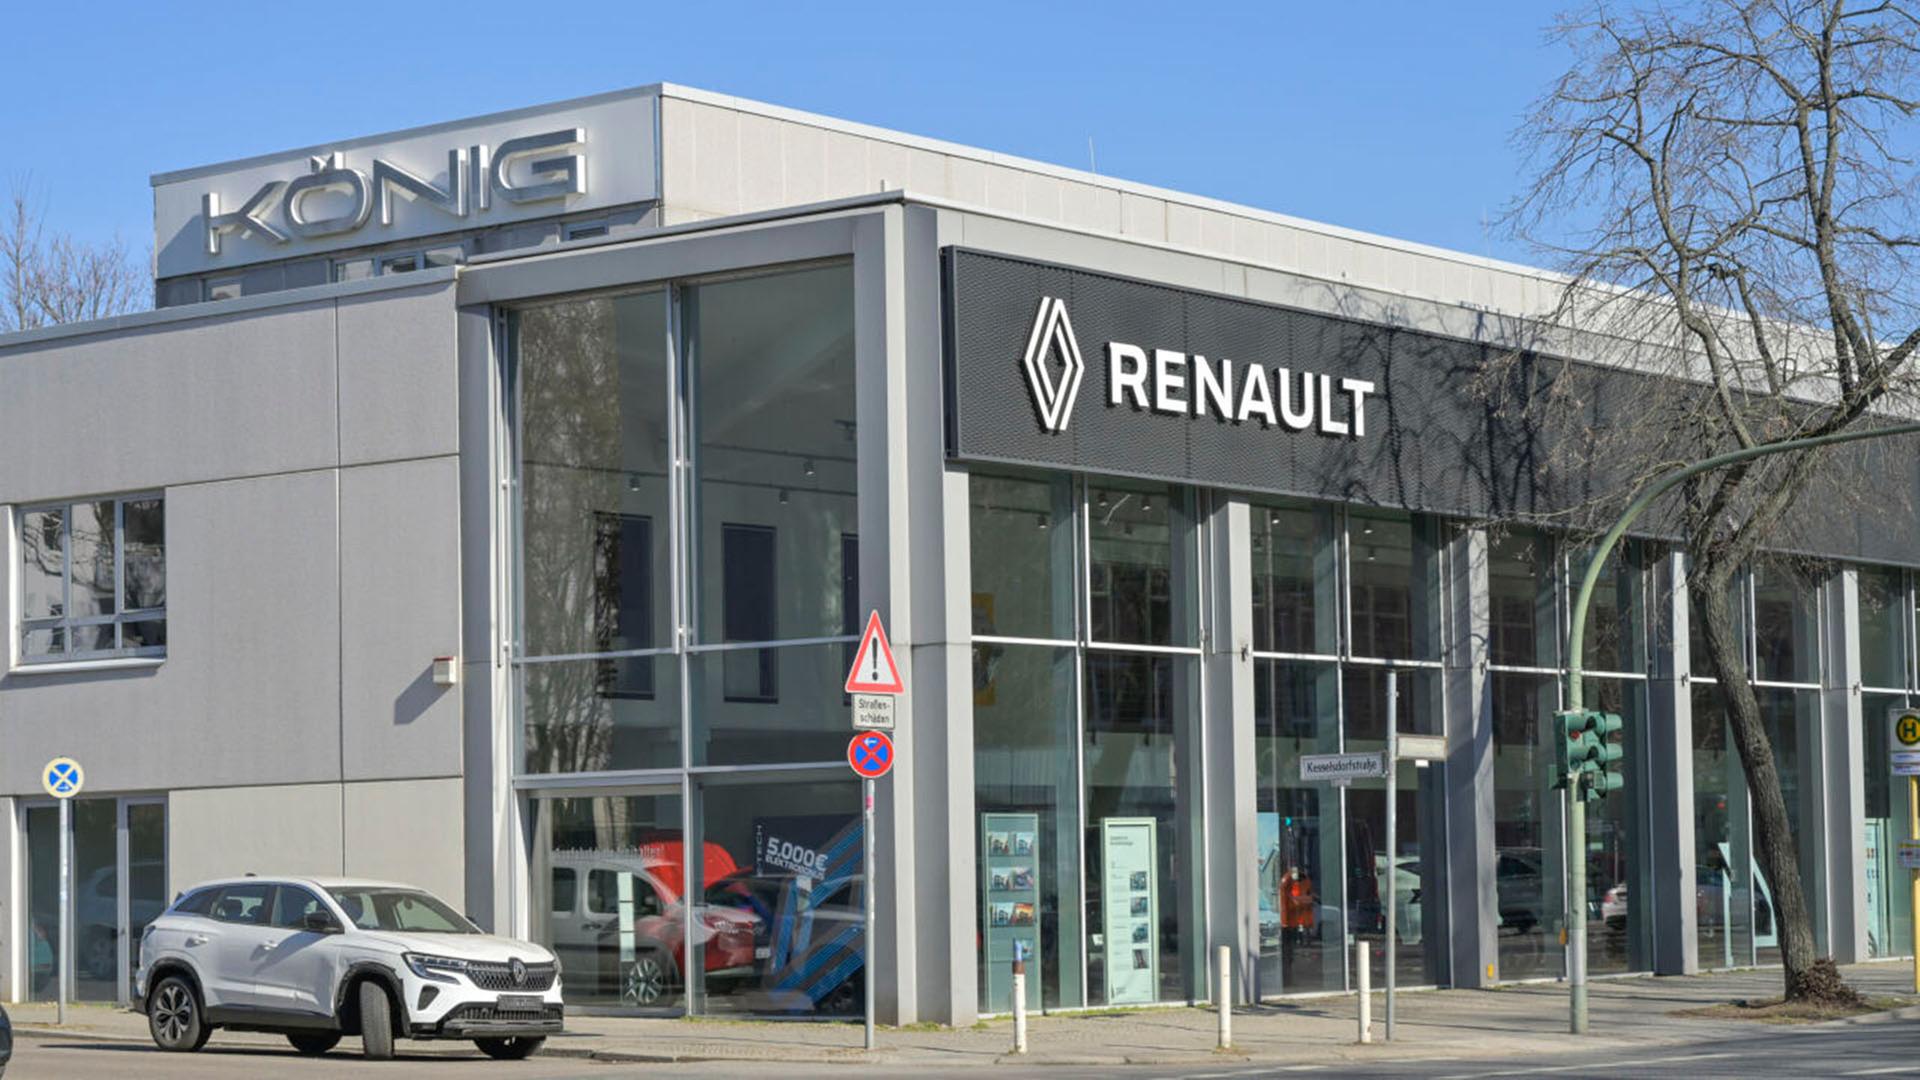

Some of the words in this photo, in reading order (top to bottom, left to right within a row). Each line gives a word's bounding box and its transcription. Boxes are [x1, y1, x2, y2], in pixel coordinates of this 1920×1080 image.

[202, 127, 587, 254] KÖNIG
[1108, 341, 1375, 437] RENAULT
[859, 699, 890, 709] Straßen-
[861, 713, 889, 724] schäden
[1307, 758, 1377, 772] Kesselsdorfstraße
[766, 836, 829, 872] 5.000€
